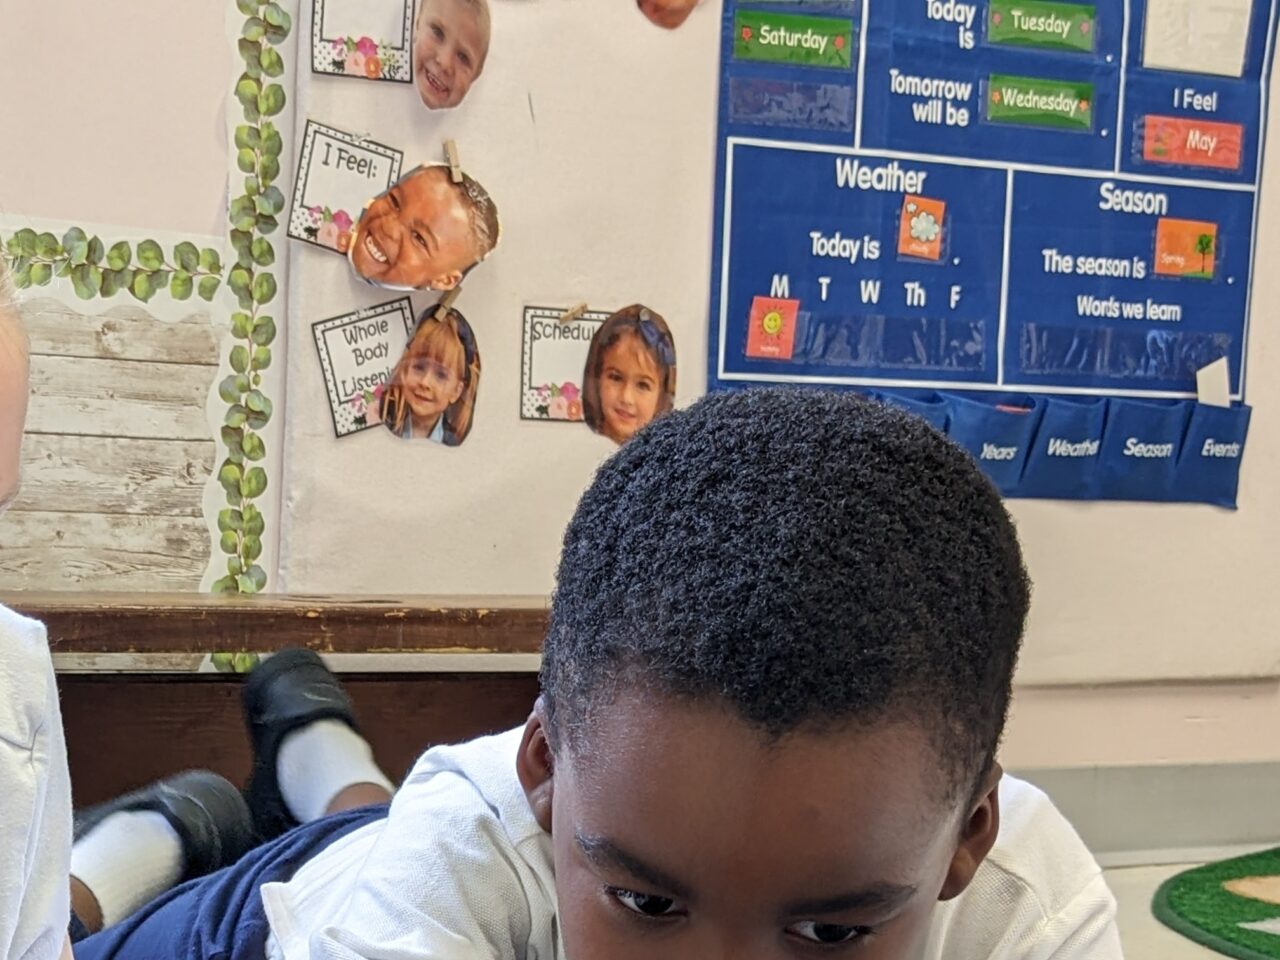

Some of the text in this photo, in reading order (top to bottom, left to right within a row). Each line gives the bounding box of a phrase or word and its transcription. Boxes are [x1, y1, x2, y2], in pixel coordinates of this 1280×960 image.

[926, 0, 976, 29] Today
[1010, 10, 1071, 38] Tuesday
[759, 25, 828, 54] Saturday
[958, 26, 975, 49] is
[889, 68, 972, 101] Tomorrow
[912, 99, 969, 127] will be
[1001, 88, 1079, 117] Wednesday
[1173, 87, 1218, 112] I Feel
[1186, 128, 1217, 157] May
[321, 141, 377, 179] I Feel:
[836, 157, 927, 194] Weather
[1099, 182, 1168, 215] Season
[810, 231, 881, 264] Today is
[1041, 248, 1146, 279] The season is
[770, 274, 962, 309] M T W Th F
[1076, 295, 1182, 322] Words we learn
[342, 320, 389, 346] Whole
[352, 341, 389, 367] Body
[980, 443, 1018, 460] Years
[1123, 438, 1174, 458] Season
[1201, 439, 1241, 458] Events
